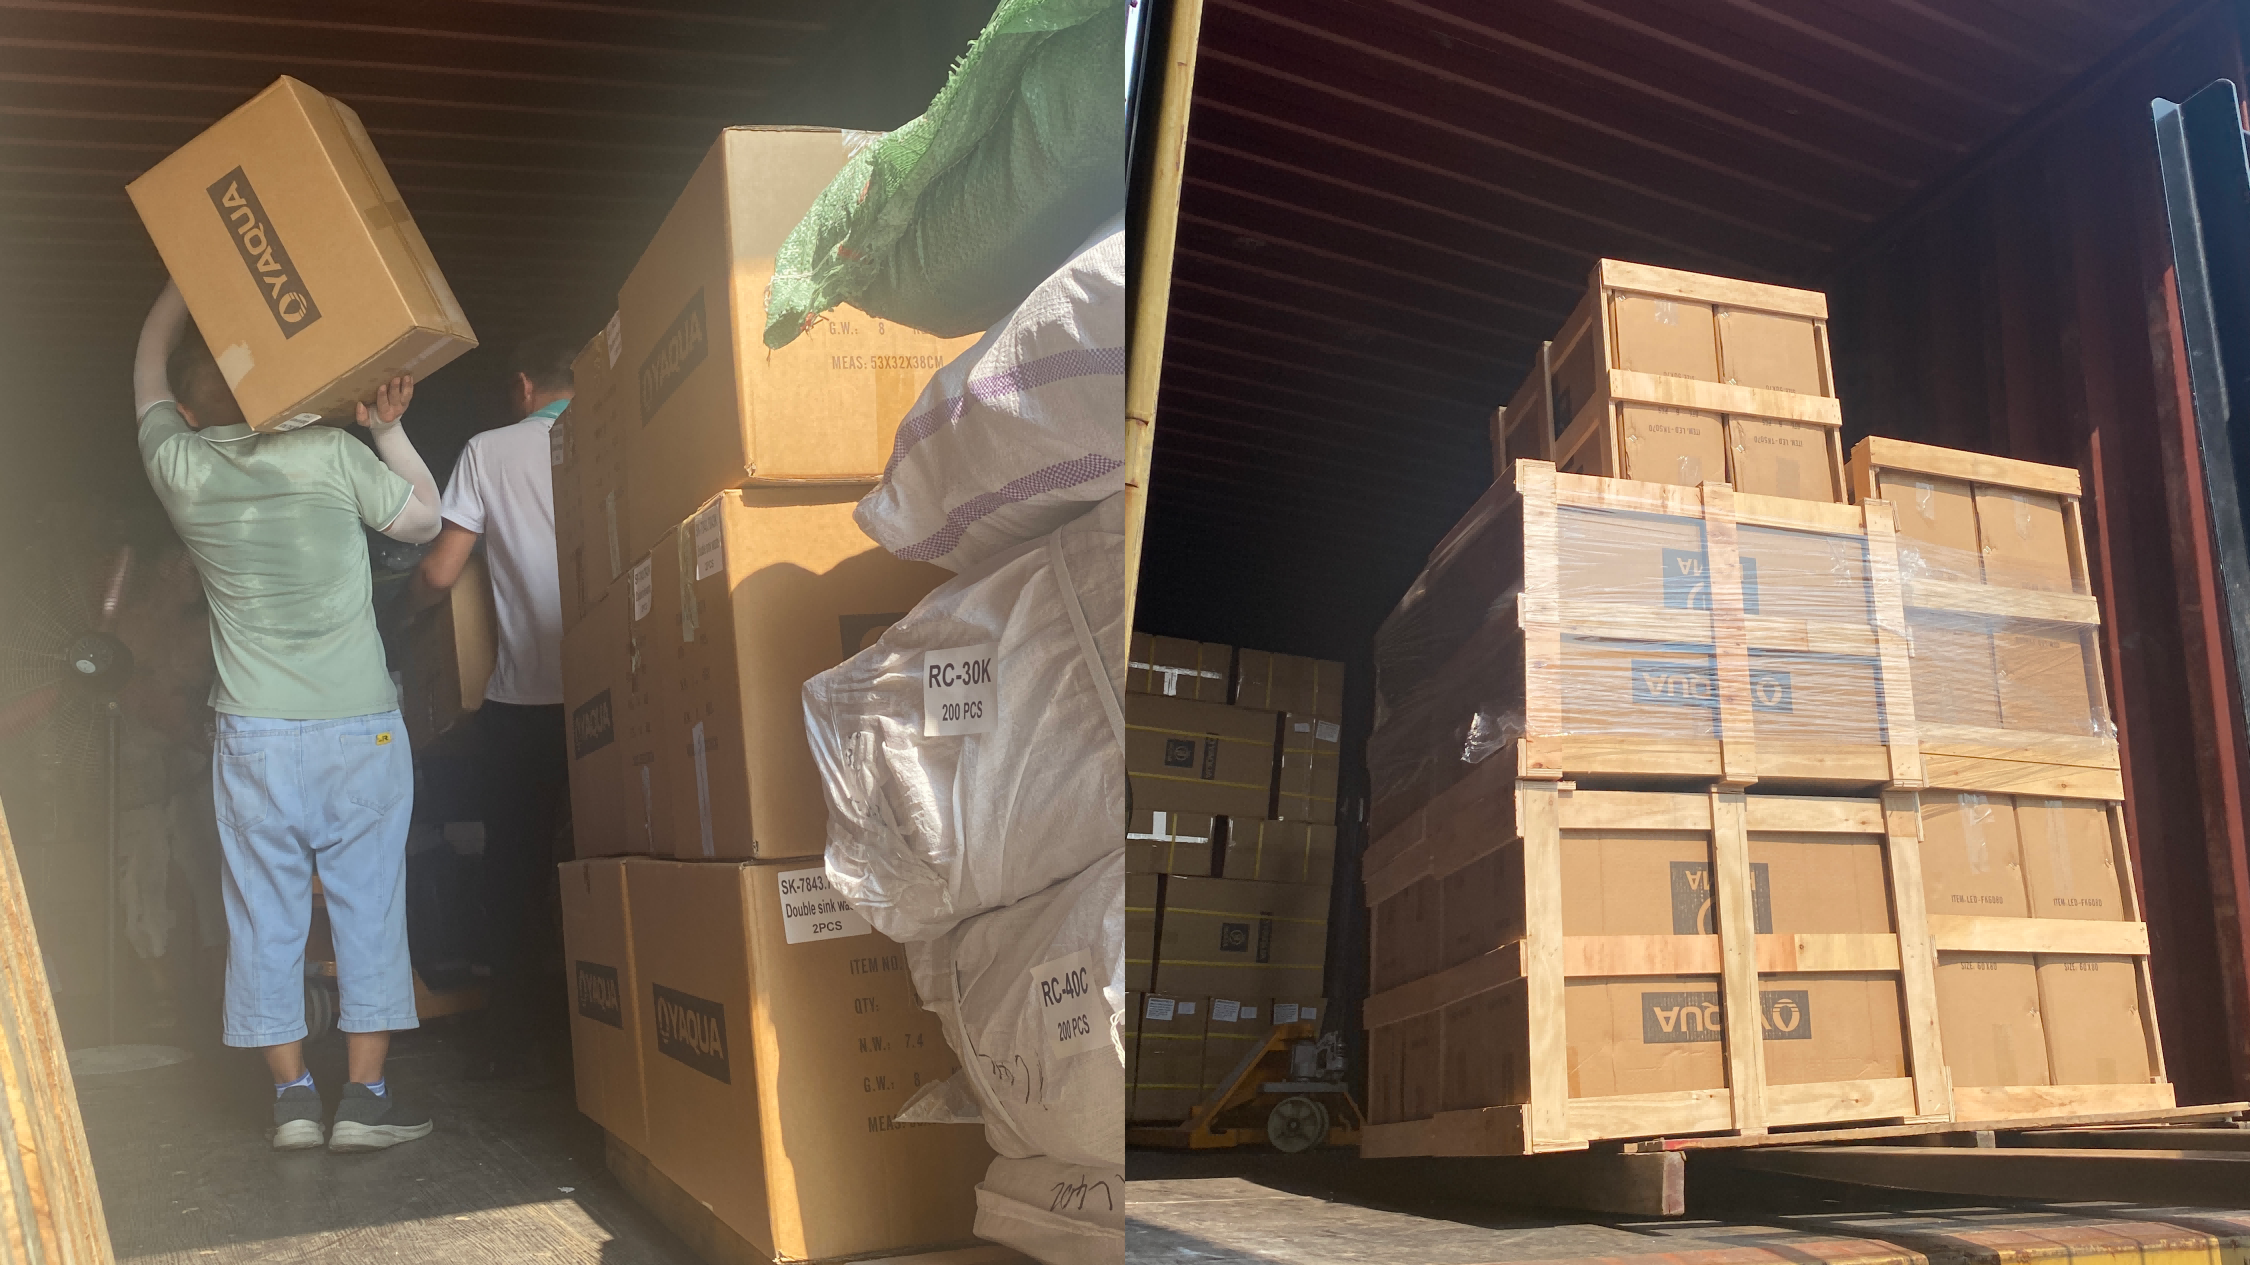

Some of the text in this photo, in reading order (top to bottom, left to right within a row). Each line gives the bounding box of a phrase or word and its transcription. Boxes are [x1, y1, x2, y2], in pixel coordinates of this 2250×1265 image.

[829, 321, 885, 335] G.W.: 8
[832, 355, 944, 370] MEAS: 53X32X38CM
[928, 658, 991, 688] RC-30K
[942, 700, 983, 721] 200 PCS
[785, 900, 816, 918] Double
[818, 898, 837, 914] sink
[812, 920, 843, 934] 2PCS
[850, 957, 878, 975] ITEM
[1041, 966, 1088, 1007] RC-40C
[854, 997, 879, 1014] QTY:
[1057, 1013, 1090, 1042] 200 PCS
[858, 1033, 924, 1053] N.W.: 7.4
[863, 1071, 921, 1093] G.W.: 8
